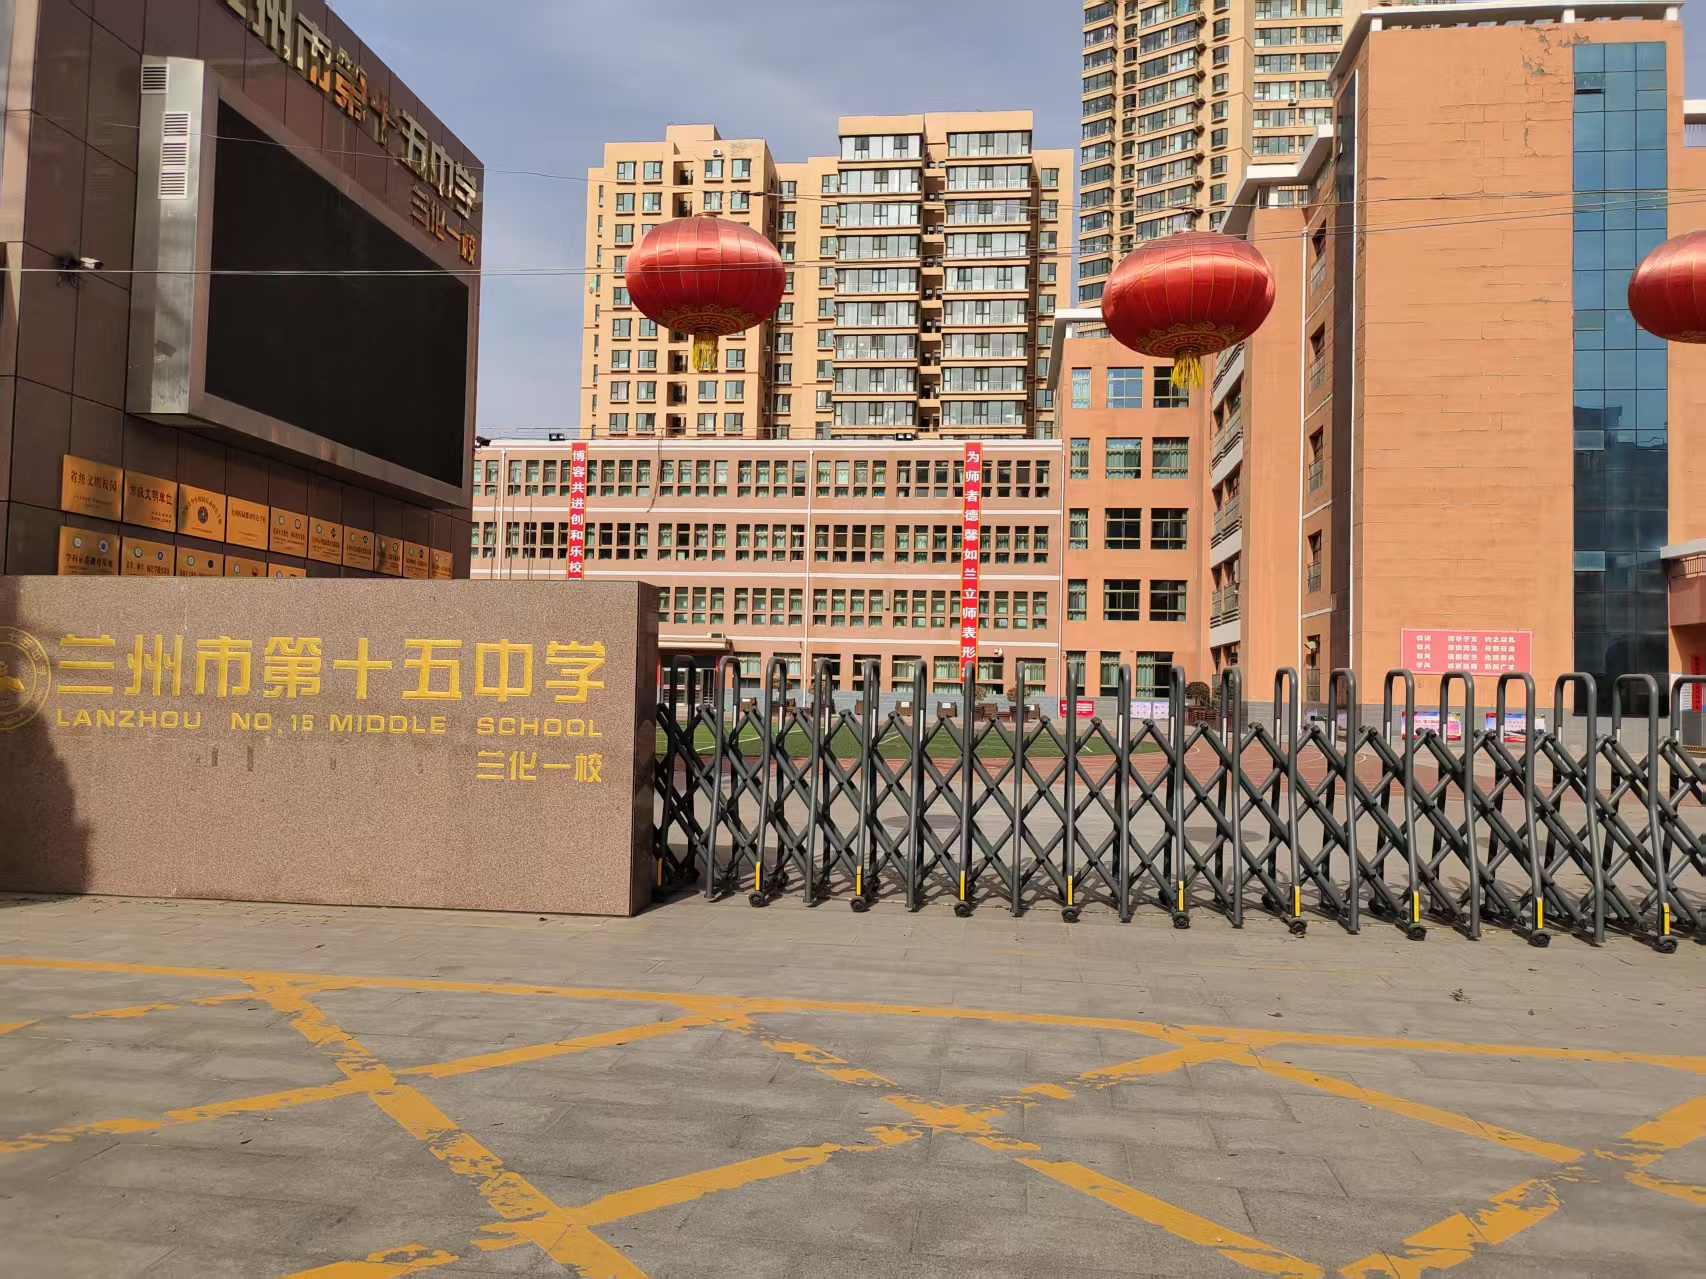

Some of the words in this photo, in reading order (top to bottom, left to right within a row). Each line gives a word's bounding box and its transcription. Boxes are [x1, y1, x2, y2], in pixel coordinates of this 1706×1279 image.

[224, 0, 478, 220] 州市第十五中学
[568, 450, 585, 580] 博容共进创和乐校
[961, 451, 980, 677] 为师者德馨如兰立师表形
[58, 634, 606, 703] 兰州市第十五中学
[57, 708, 202, 730] LANZHOU
[329, 714, 447, 735] MIDDLE
[476, 717, 603, 738] SCHOOL
[476, 750, 603, 783] 兰化一校
